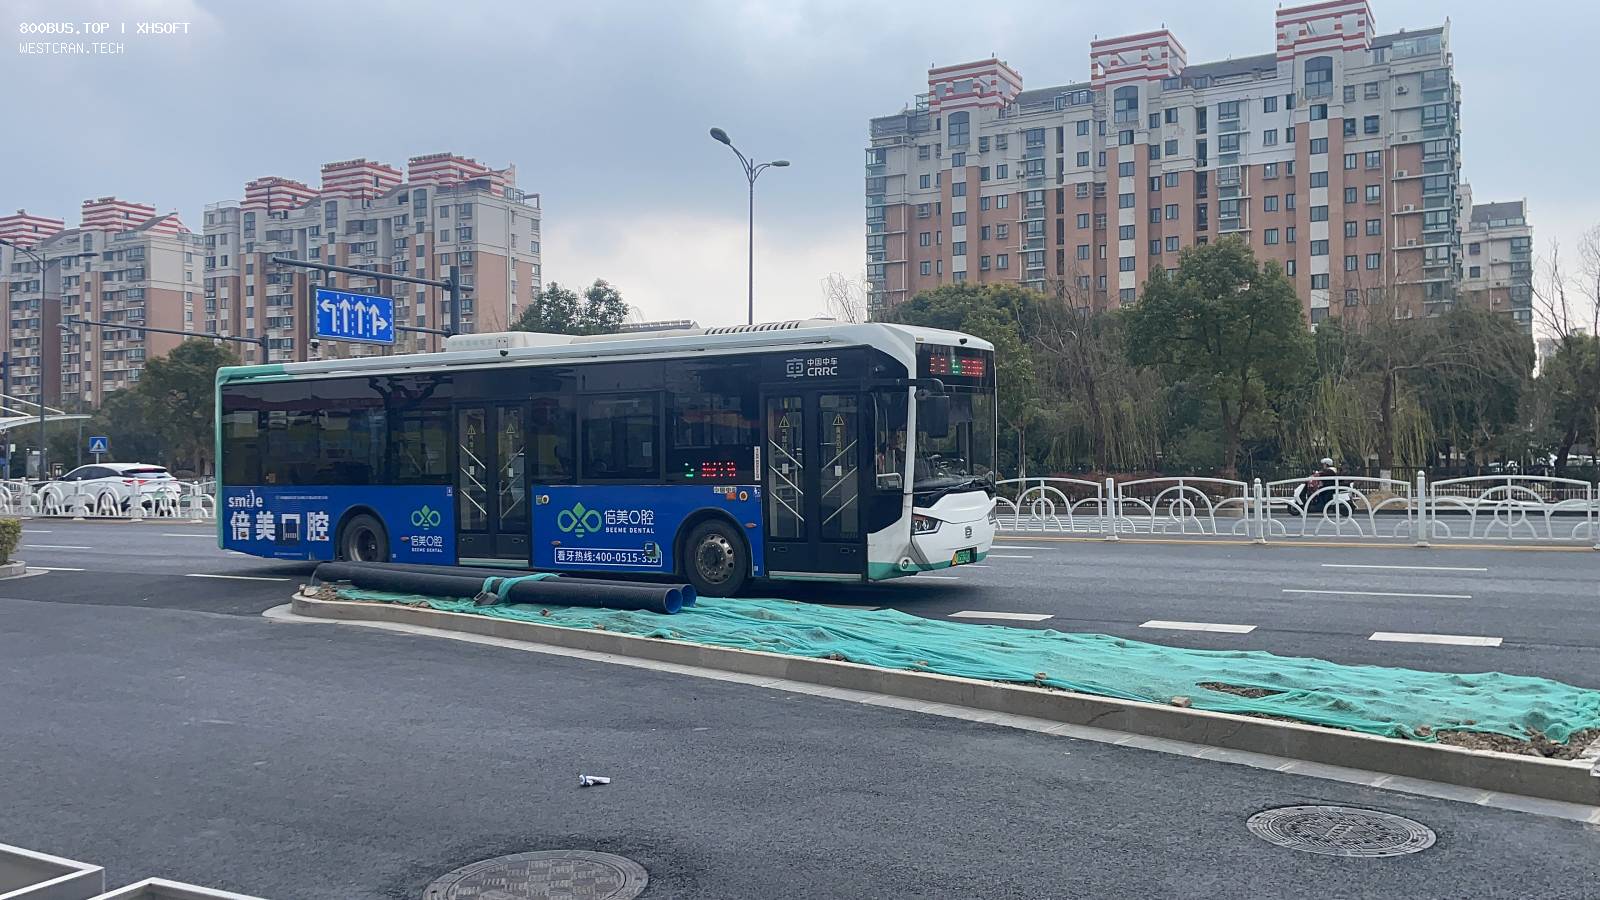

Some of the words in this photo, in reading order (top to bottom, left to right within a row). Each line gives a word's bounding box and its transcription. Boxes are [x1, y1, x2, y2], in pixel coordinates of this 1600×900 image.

[807, 357, 838, 367] 中国中车
[807, 366, 838, 377] CRRC
[228, 489, 263, 508] smile
[604, 509, 654, 525] 倍美口腔
[230, 511, 330, 542] 倍美口腔
[411, 535, 443, 547] 倍美口腔
